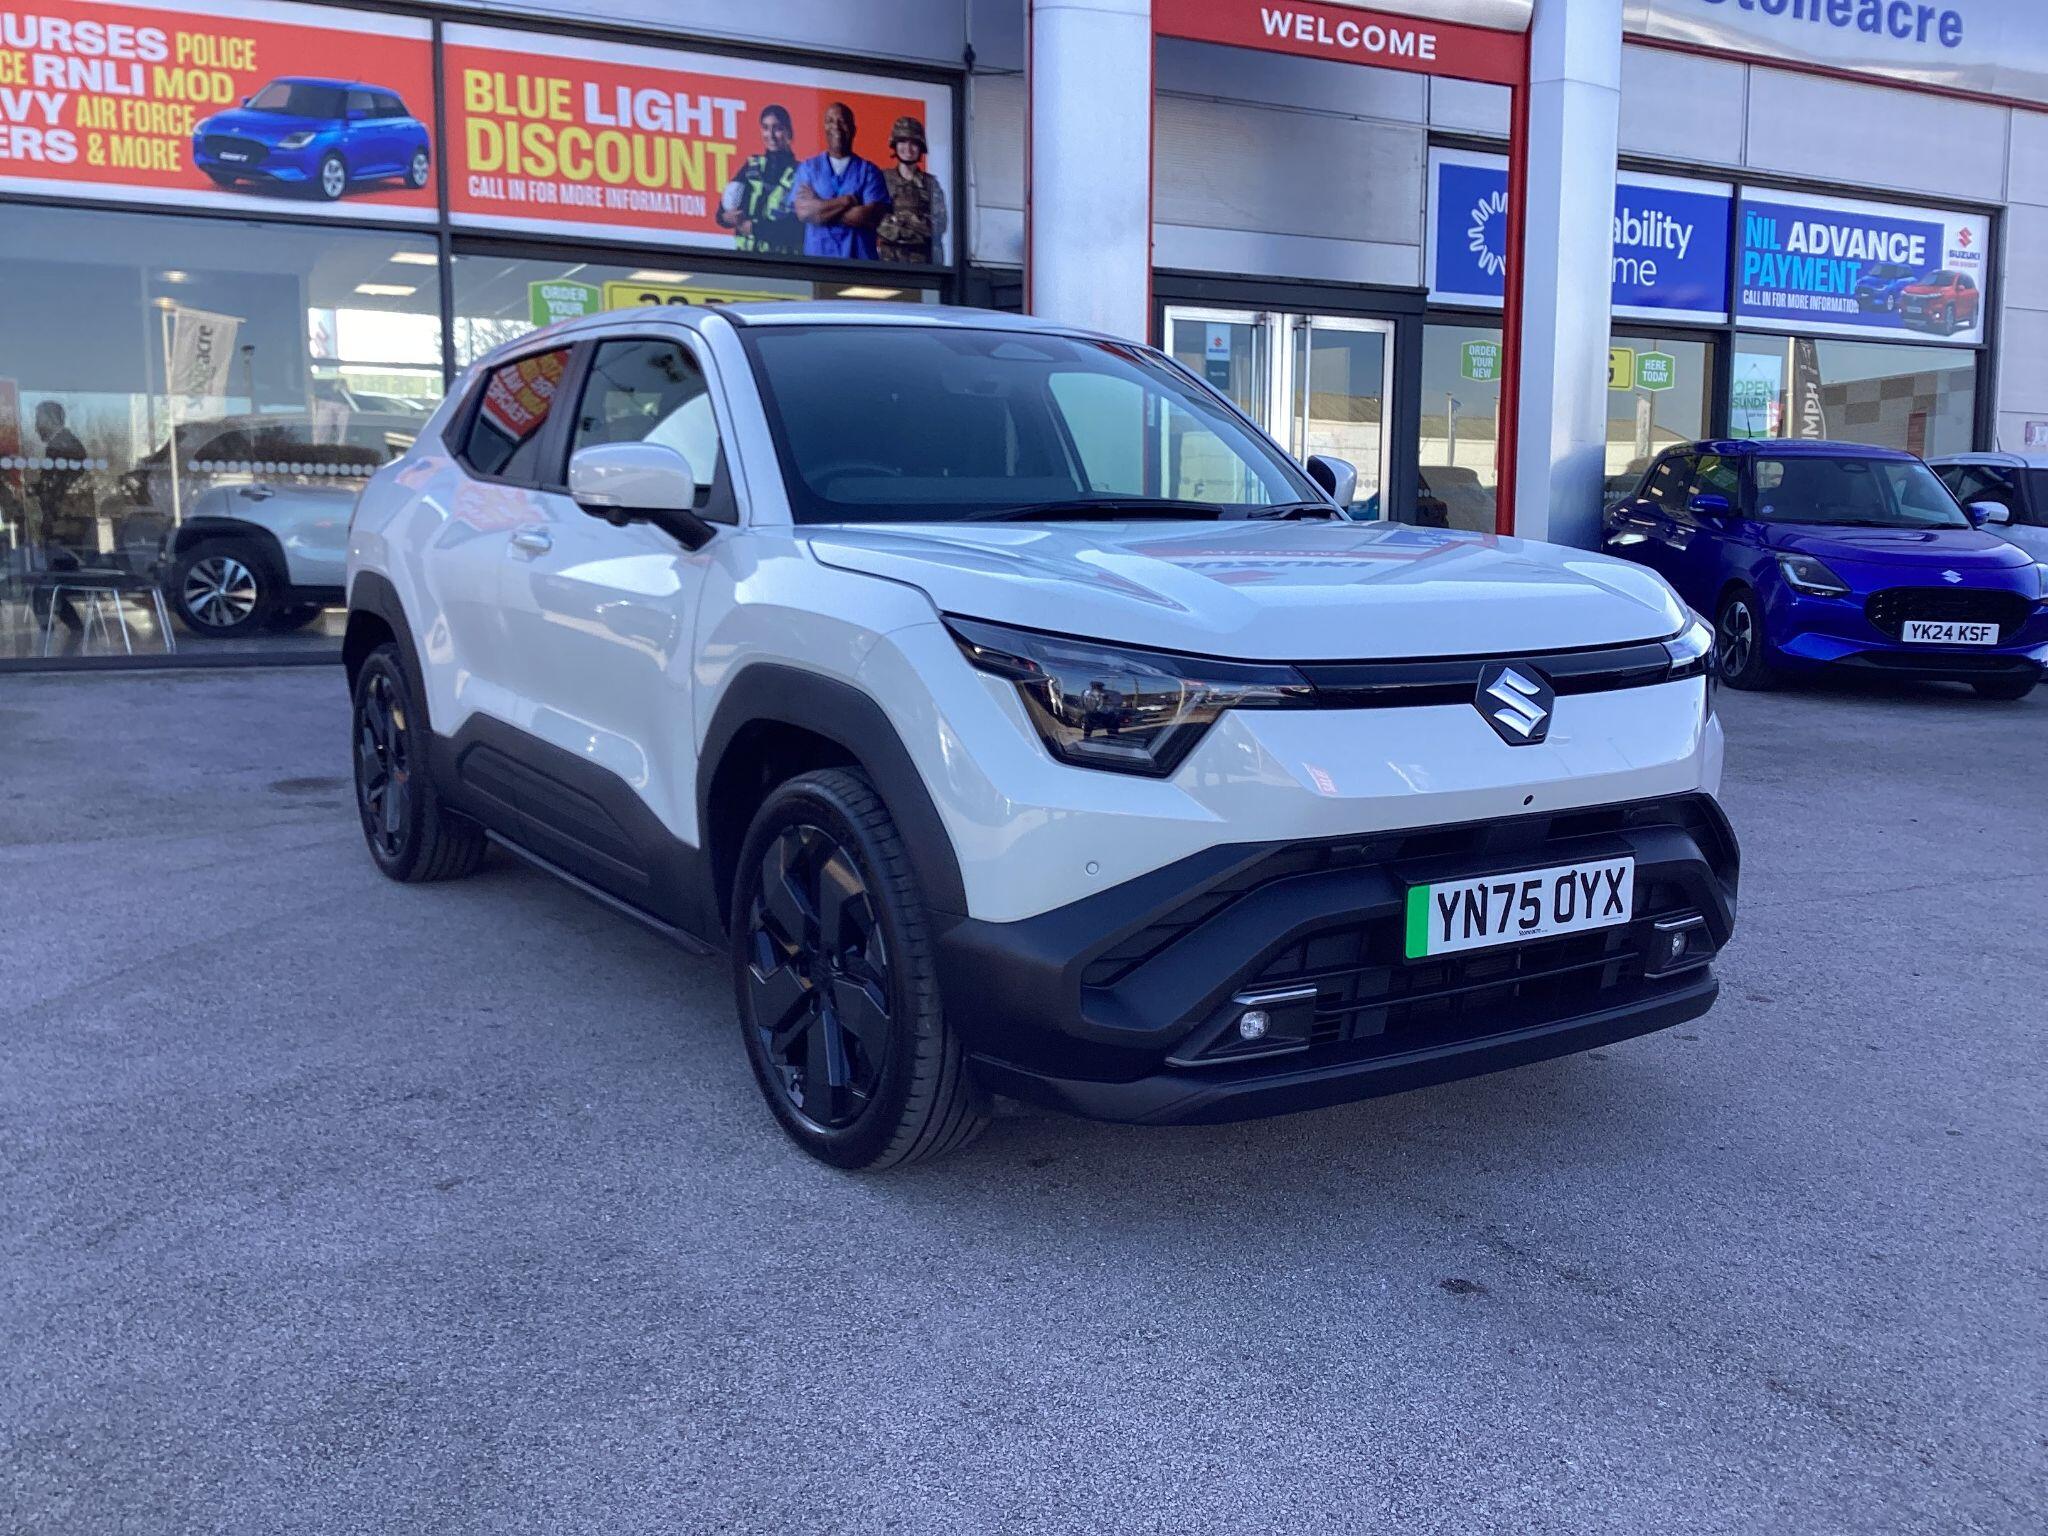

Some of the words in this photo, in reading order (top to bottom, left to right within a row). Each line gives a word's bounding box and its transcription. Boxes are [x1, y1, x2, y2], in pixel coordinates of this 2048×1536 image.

[0, 12, 168, 62] URSES
[175, 31, 258, 71] POLICE
[1261, 8, 1437, 60] WELCOME
[1703, 0, 1963, 48] neacre
[33, 53, 145, 97] RNLI
[152, 65, 235, 104] MOD
[0, 87, 68, 125] VY
[76, 94, 118, 130] AIR
[121, 98, 197, 136] FORCE
[463, 69, 573, 121] BLUE
[583, 82, 747, 139] LIGHT
[87, 132, 105, 166] &
[109, 135, 182, 172] MORE
[465, 117, 737, 193] DISCOUNT
[468, 175, 505, 199] CALL
[508, 179, 526, 202] IN
[528, 181, 558, 204] FOR
[560, 183, 604, 208] MORE
[605, 187, 706, 217] INFORMATION
[1786, 221, 1926, 266] ADVANCE
[1744, 251, 1862, 295] PAYMENT
[1743, 289, 1761, 306] CALL
[1762, 291, 1771, 306] IN
[1772, 292, 1787, 307] FOR
[1787, 293, 1809, 309] MORE
[1809, 295, 1859, 314] INFORMATION
[1468, 344, 1497, 357] ORDER
[1471, 355, 1494, 368] YOUR
[1645, 359, 1667, 371] HERE
[1472, 367, 1492, 378] NEW
[1642, 370, 1669, 383] TODAY
[1733, 380, 1774, 397] OPEN
[1731, 396, 1771, 409] SUNDA
[1912, 623, 1954, 641] YK24
[1958, 625, 1992, 641] KSF
[1437, 879, 1543, 942] YN75
